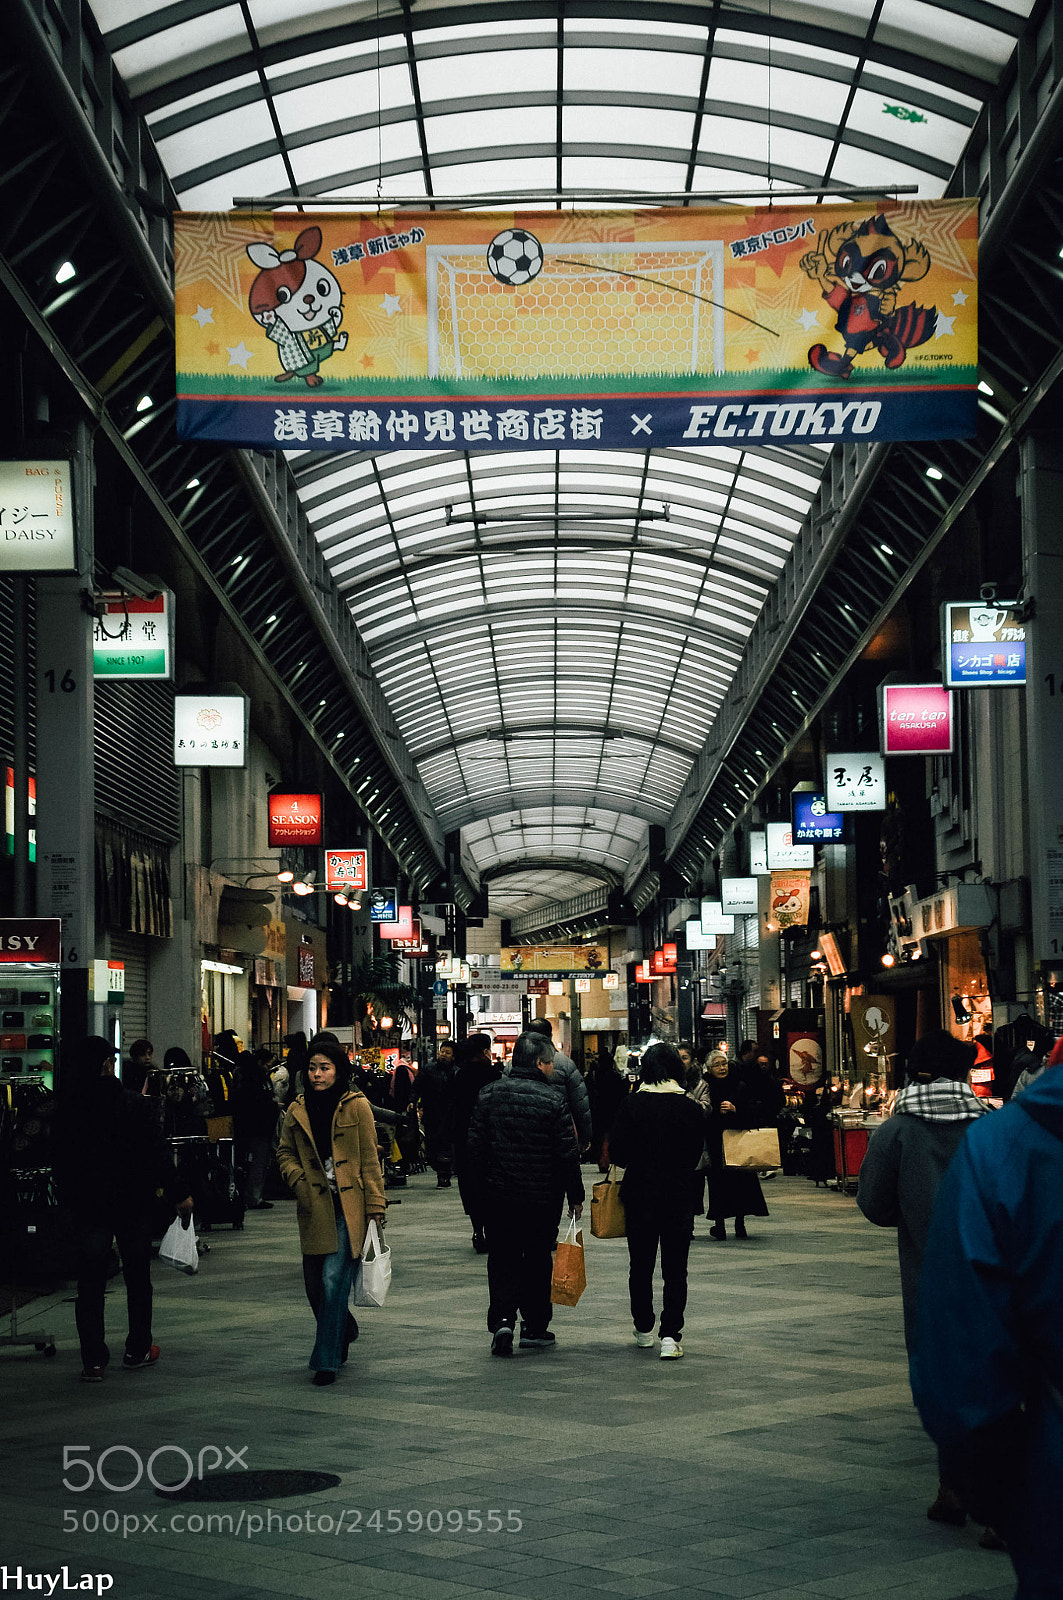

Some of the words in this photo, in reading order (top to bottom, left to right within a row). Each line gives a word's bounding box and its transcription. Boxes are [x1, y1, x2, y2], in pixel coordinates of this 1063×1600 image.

[730, 217, 817, 259] 東京ドロンパ
[331, 244, 365, 268] 浅草
[367, 226, 426, 257] 新にゃか
[273, 407, 604, 442] 浅草新仲見世商店街
[682, 401, 882, 439] F.C.TOKYO
[25, 467, 50, 477] BAG
[5, 529, 58, 541] DAISY
[106, 656, 125, 666] SINCE
[127, 655, 146, 665] 1907
[957, 653, 1021, 668] シカゴ靴店
[979, 669, 994, 677] Shop
[44, 669, 76, 693] 16
[889, 709, 916, 722] ten
[920, 708, 947, 721] ten
[899, 722, 937, 730] ASAKUSA
[833, 765, 879, 788] 玉屋
[290, 801, 300, 813] 4
[271, 815, 319, 826] SEASON
[274, 828, 317, 836] アウトレットショップ
[328, 854, 364, 868] かっぱ
[334, 866, 358, 879] 寿司
[354, 925, 368, 936] 17
[424, 965, 434, 973] 19
